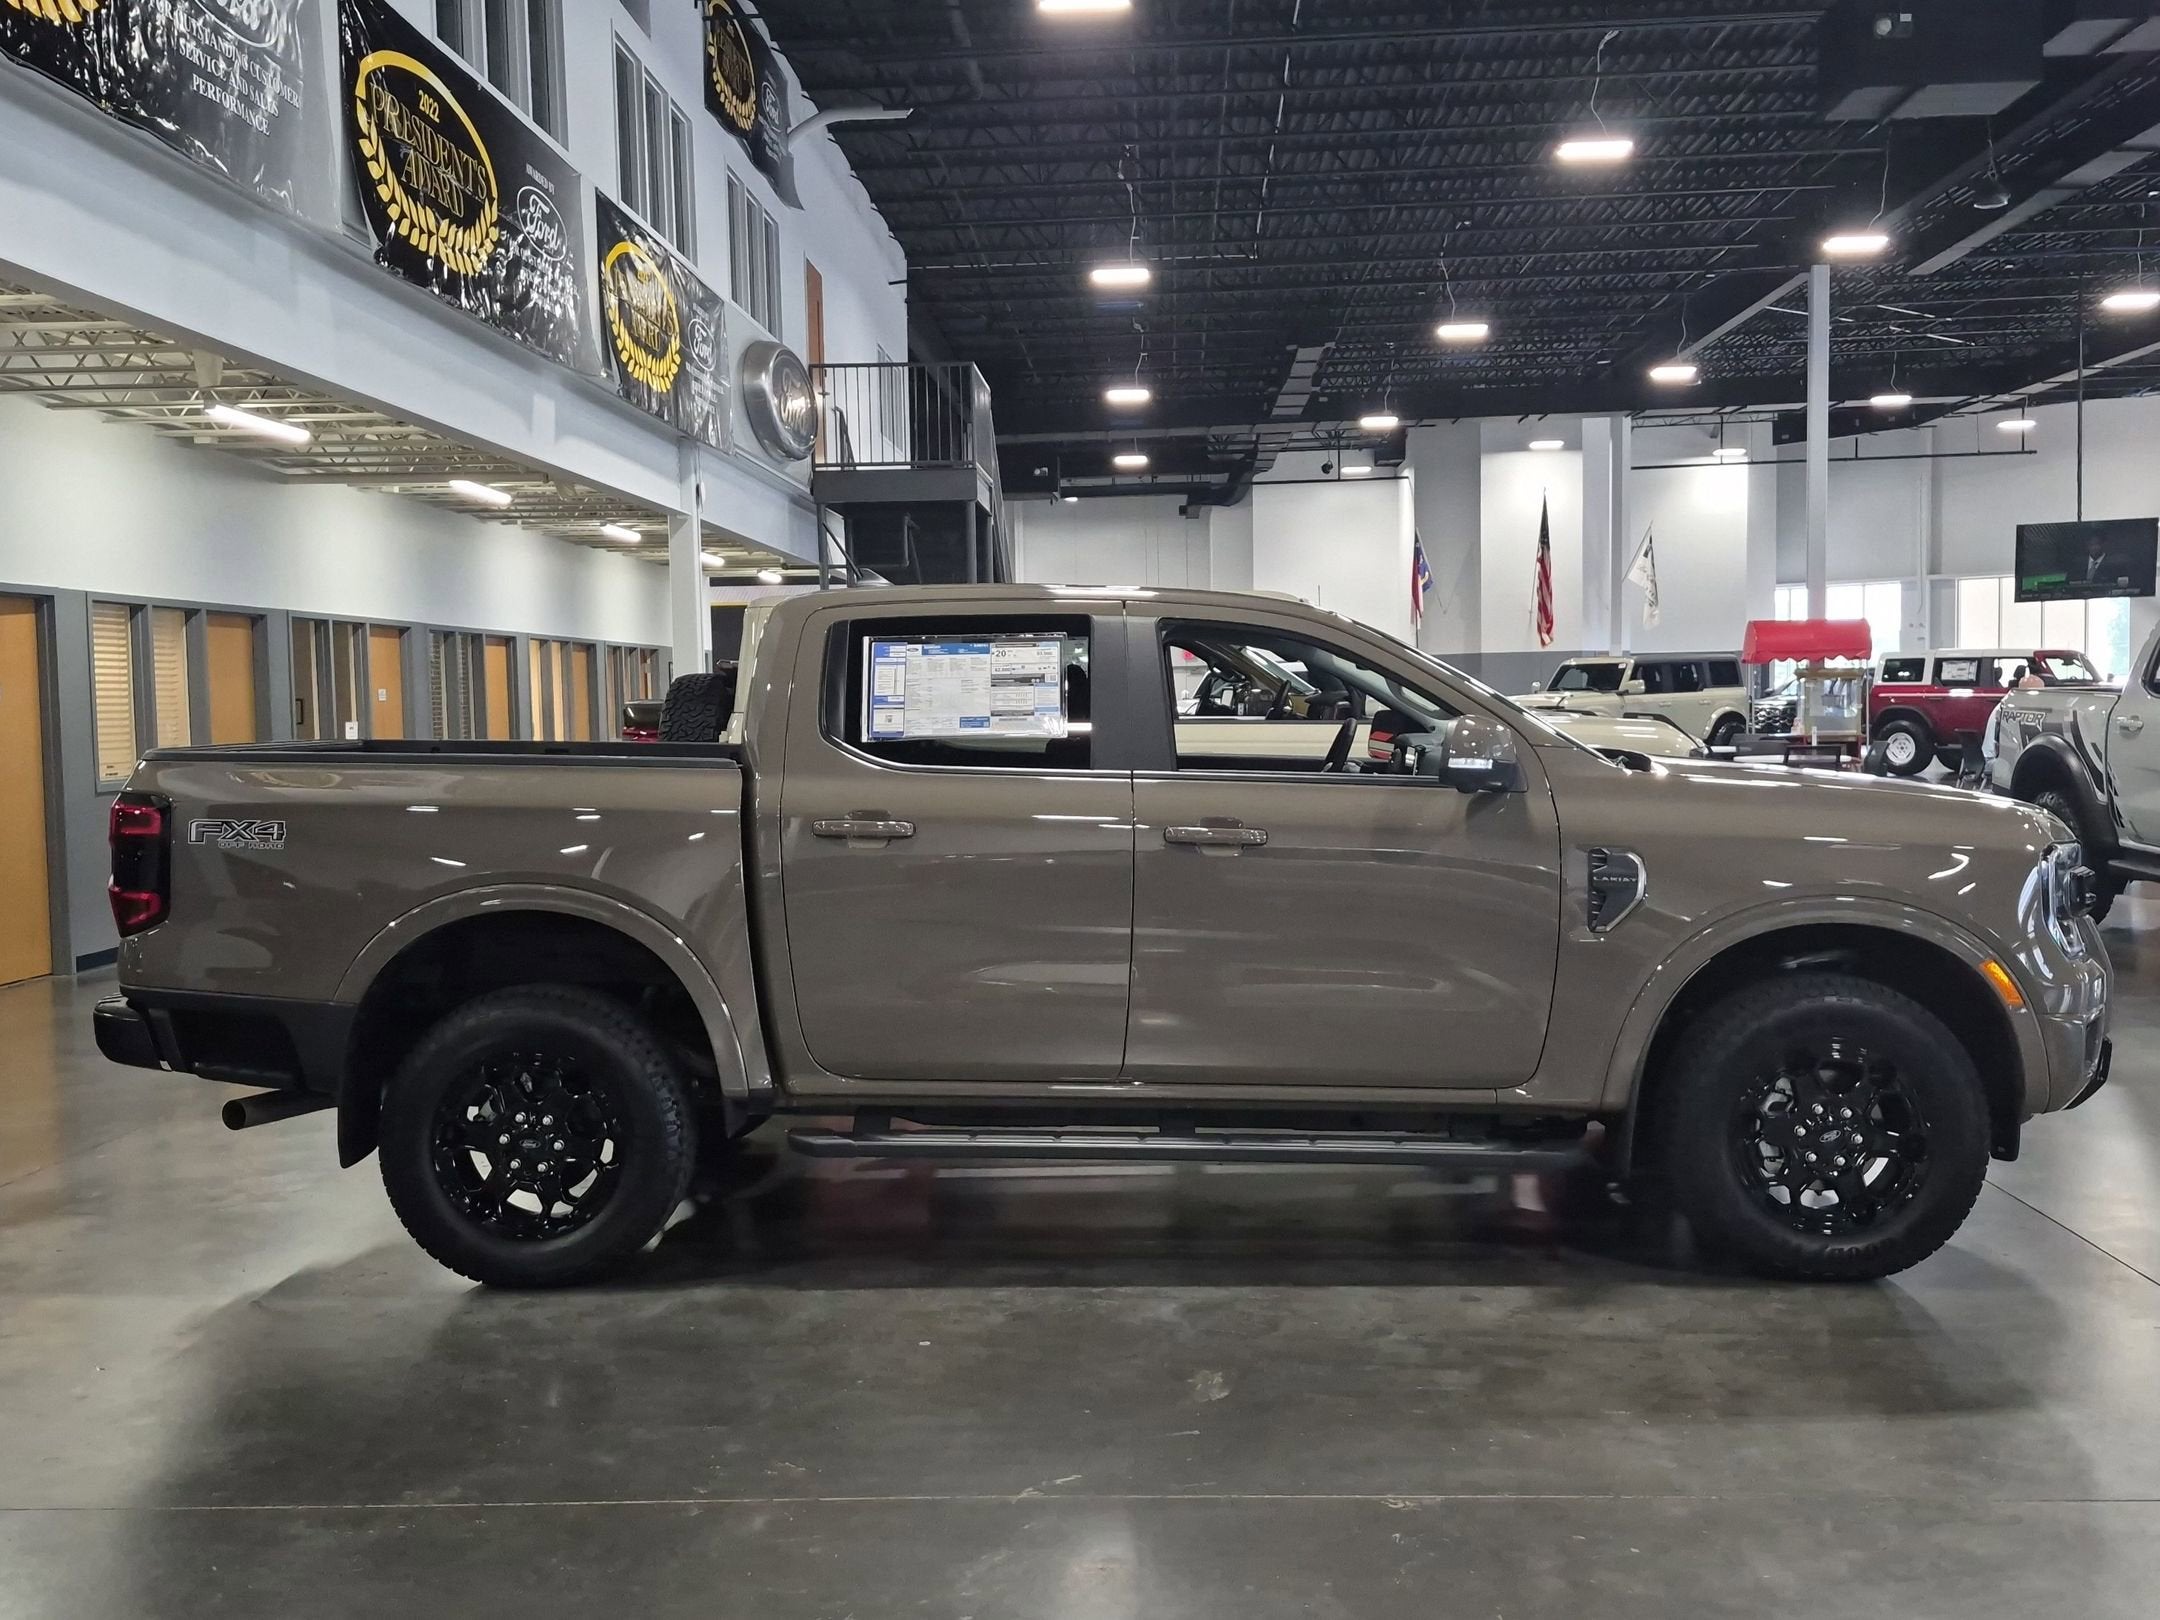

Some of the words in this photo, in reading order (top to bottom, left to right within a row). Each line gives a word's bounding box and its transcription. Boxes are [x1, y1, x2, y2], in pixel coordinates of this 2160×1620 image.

[179, 37, 227, 81] SERVICE
[228, 68, 249, 96] AND
[250, 85, 279, 117] SALES
[192, 73, 270, 136] PERFORMANCE
[418, 90, 440, 123] 2022
[369, 82, 488, 200] PRESIDENT'S
[400, 149, 464, 218] AWARD
[523, 192, 563, 255] Ford
[691, 322, 714, 367] Ford
[2002, 710, 2046, 731] RAPTOR
[188, 819, 286, 844] FX4
